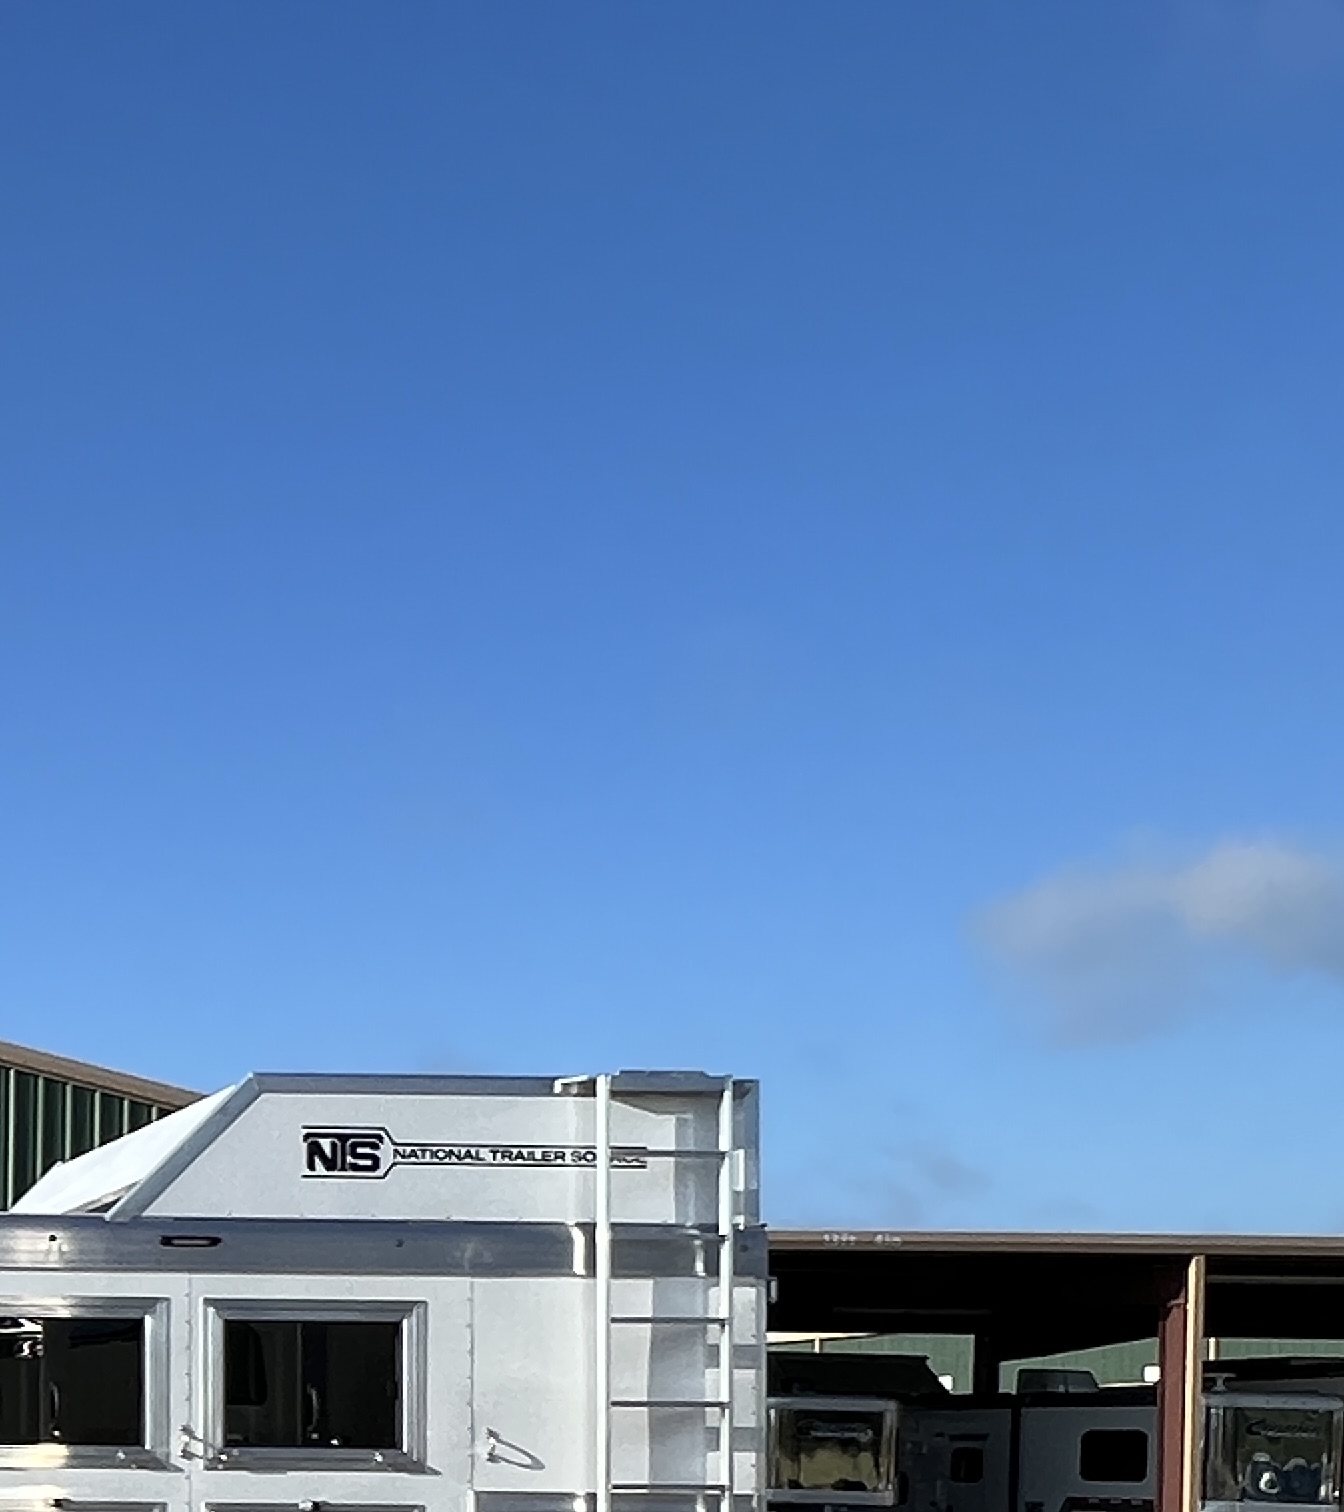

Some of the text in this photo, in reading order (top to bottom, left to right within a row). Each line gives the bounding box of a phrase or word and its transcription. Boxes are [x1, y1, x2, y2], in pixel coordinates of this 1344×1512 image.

[302, 1132, 383, 1172] NTS
[392, 1148, 485, 1161] NATIONAL
[489, 1149, 566, 1163] TRAILER
